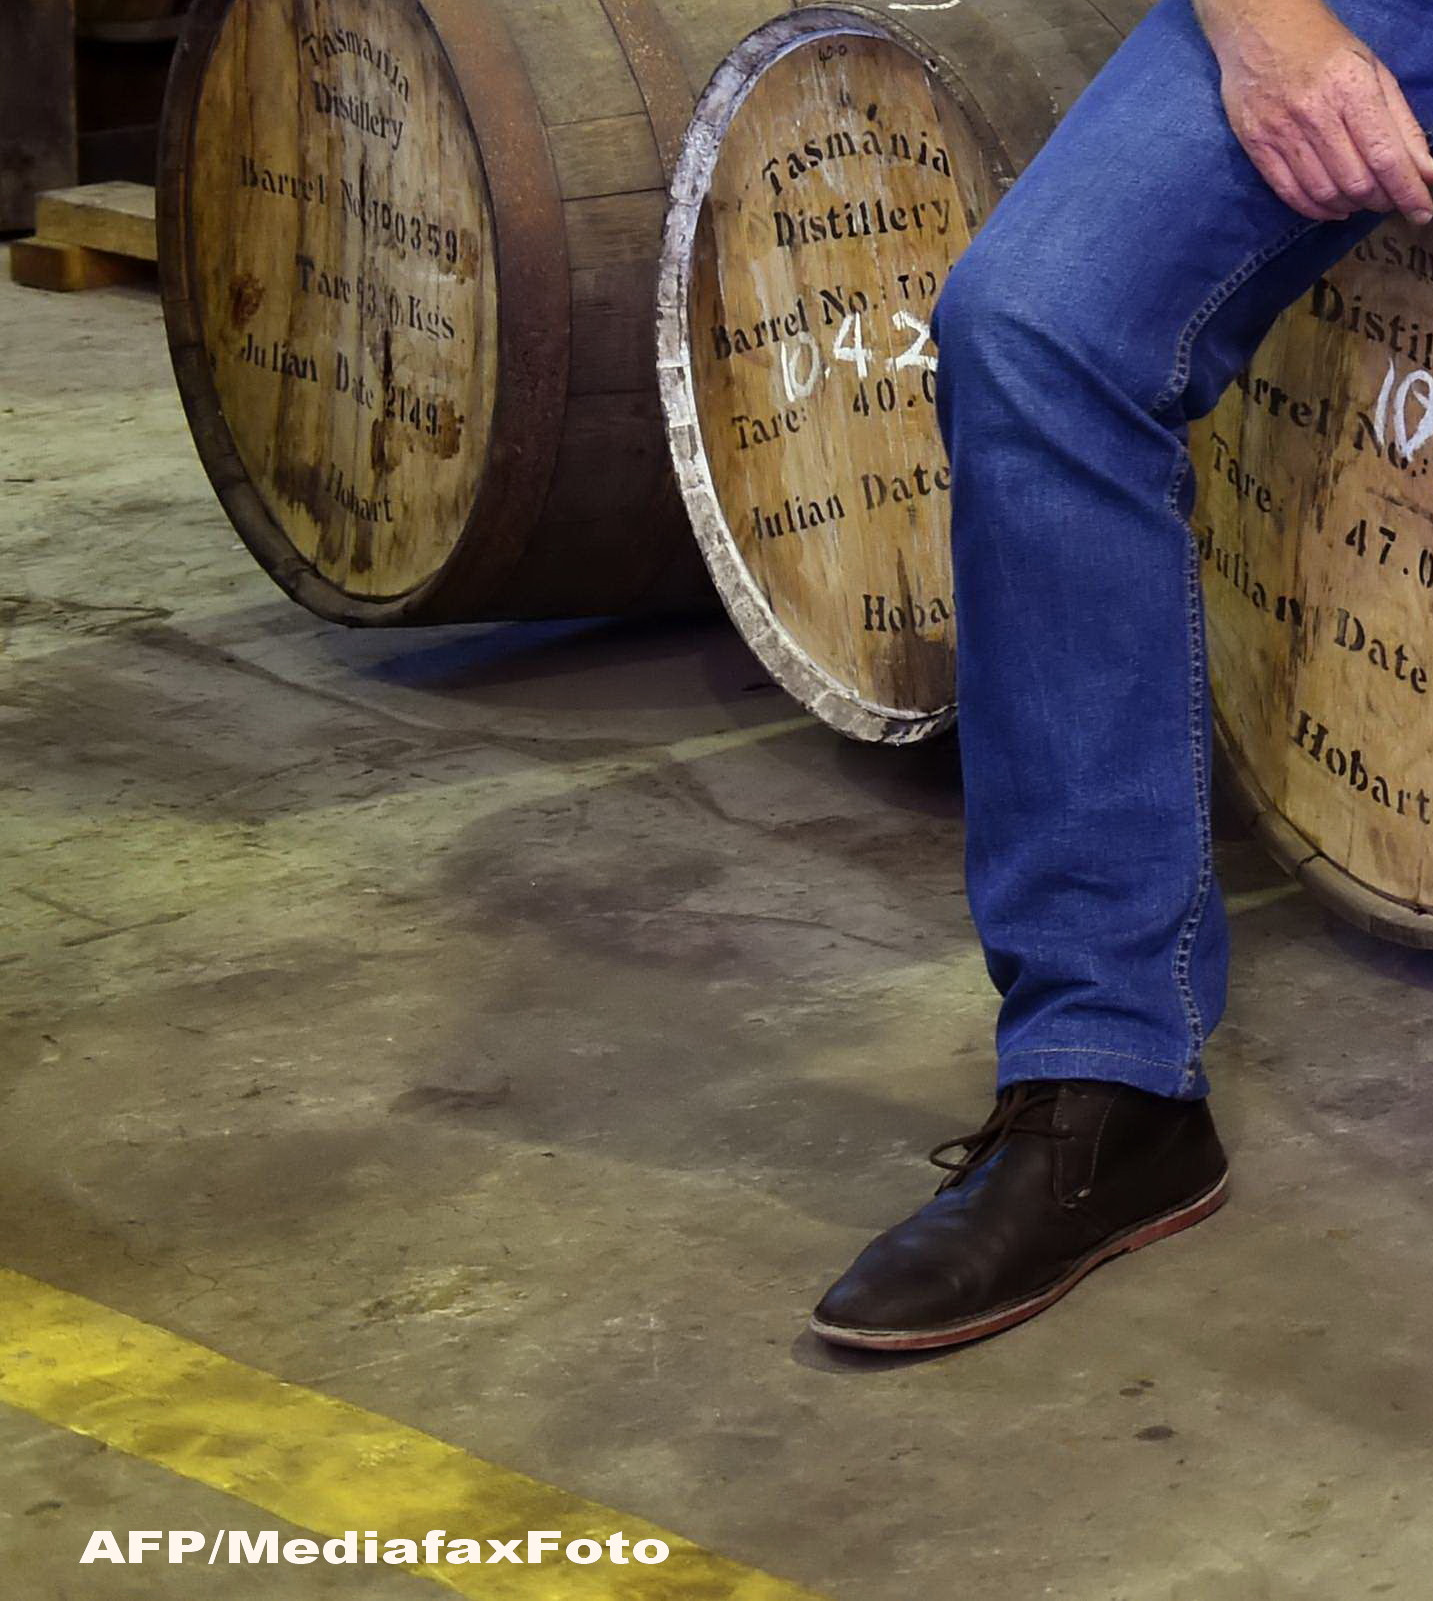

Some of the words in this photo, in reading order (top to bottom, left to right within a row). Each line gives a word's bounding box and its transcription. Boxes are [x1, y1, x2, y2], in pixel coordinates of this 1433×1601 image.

[302, 30, 411, 103] Tasmania
[311, 79, 405, 151] Distillery
[239, 155, 328, 207] Barrel
[761, 124, 953, 197] Tasmania
[772, 198, 951, 250] Distillery
[238, 331, 319, 384] Julian
[711, 296, 809, 360] Barrel
[1237, 373, 1331, 435] arrel
[325, 461, 395, 525] Hobart
[750, 489, 846, 542] Julian
[1197, 525, 1304, 629] Julian
[862, 594, 956, 633] Hoba
[1293, 708, 1432, 825] Hobart
